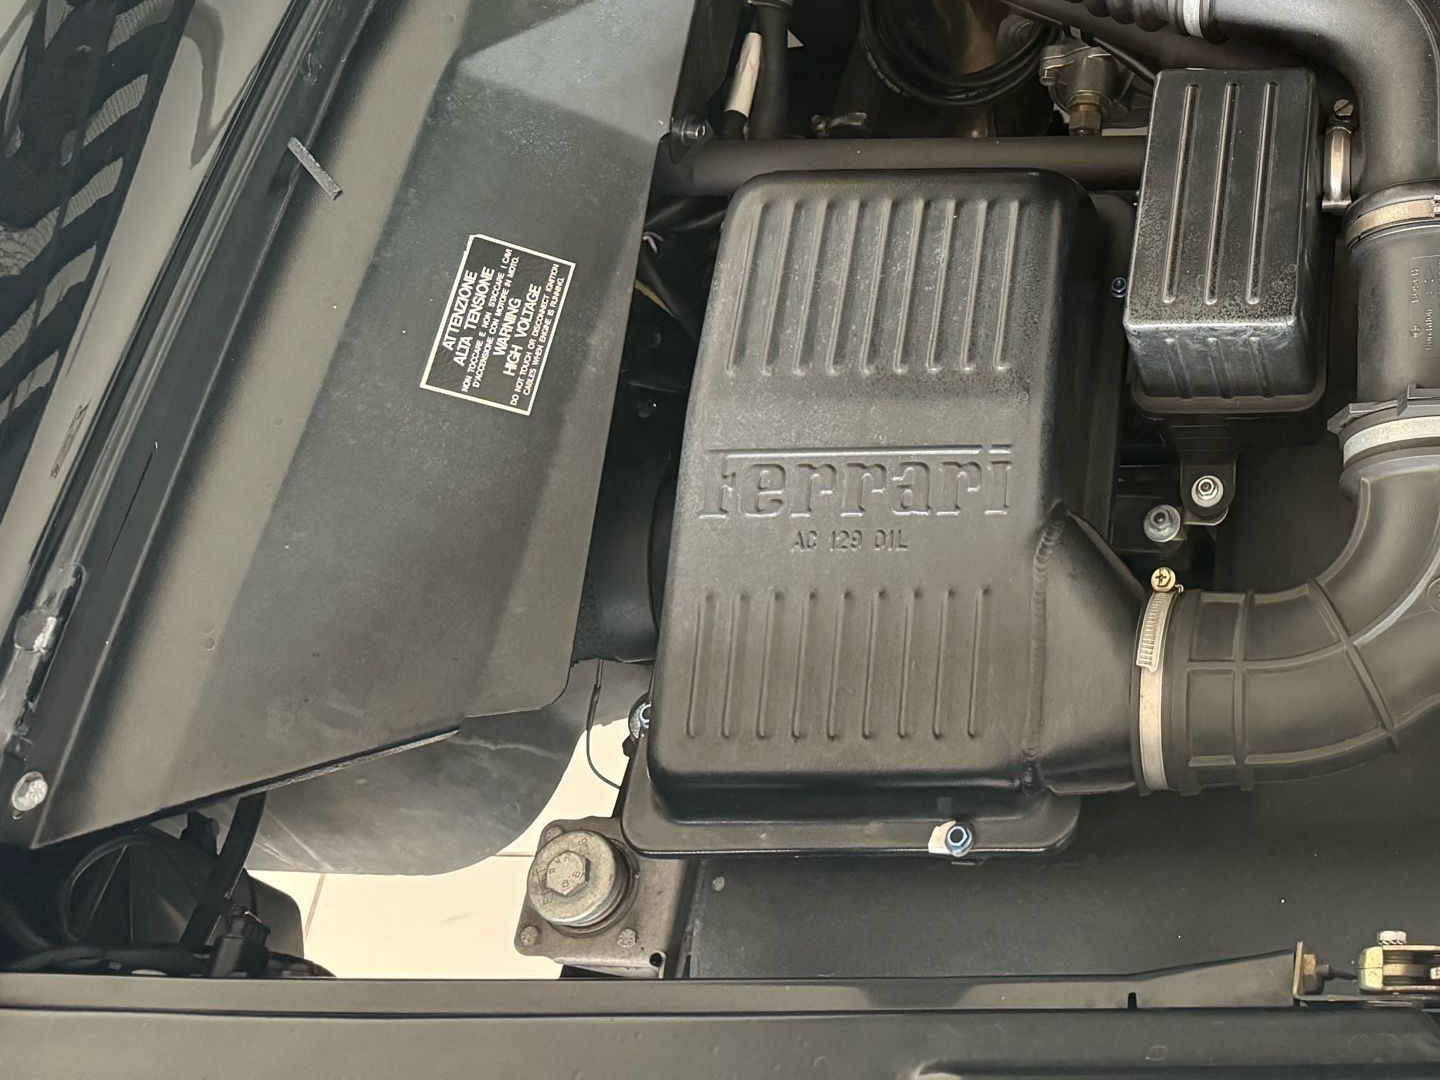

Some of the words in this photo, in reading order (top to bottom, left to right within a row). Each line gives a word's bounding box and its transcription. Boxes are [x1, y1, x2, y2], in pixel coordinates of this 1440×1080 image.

[442, 269, 477, 352] ATTENZIONE
[453, 336, 473, 367] ALTA
[463, 266, 494, 329] TENSIONE
[461, 375, 472, 392] NON
[467, 339, 483, 373] TOCCARE
[481, 311, 492, 328] NON
[488, 272, 505, 307] STACCARE
[488, 318, 500, 334] CON
[494, 288, 509, 316] MOTORE
[492, 297, 522, 355] WARNING
[502, 344, 523, 376] HIGH
[514, 283, 541, 337] VOLTAGE
[531, 293, 549, 336] DISCONNECT
[519, 351, 533, 375] TOUCH
[522, 368, 537, 395] CABLES
[531, 344, 544, 365] WHEN
[538, 318, 552, 343] ENGINE
[527, 338, 536, 349] OR
[510, 394, 519, 406] DO
[514, 376, 524, 392] NOT
[698, 443, 1013, 519] Ferrari
[791, 529, 818, 551] AC
[830, 529, 863, 551] 129
